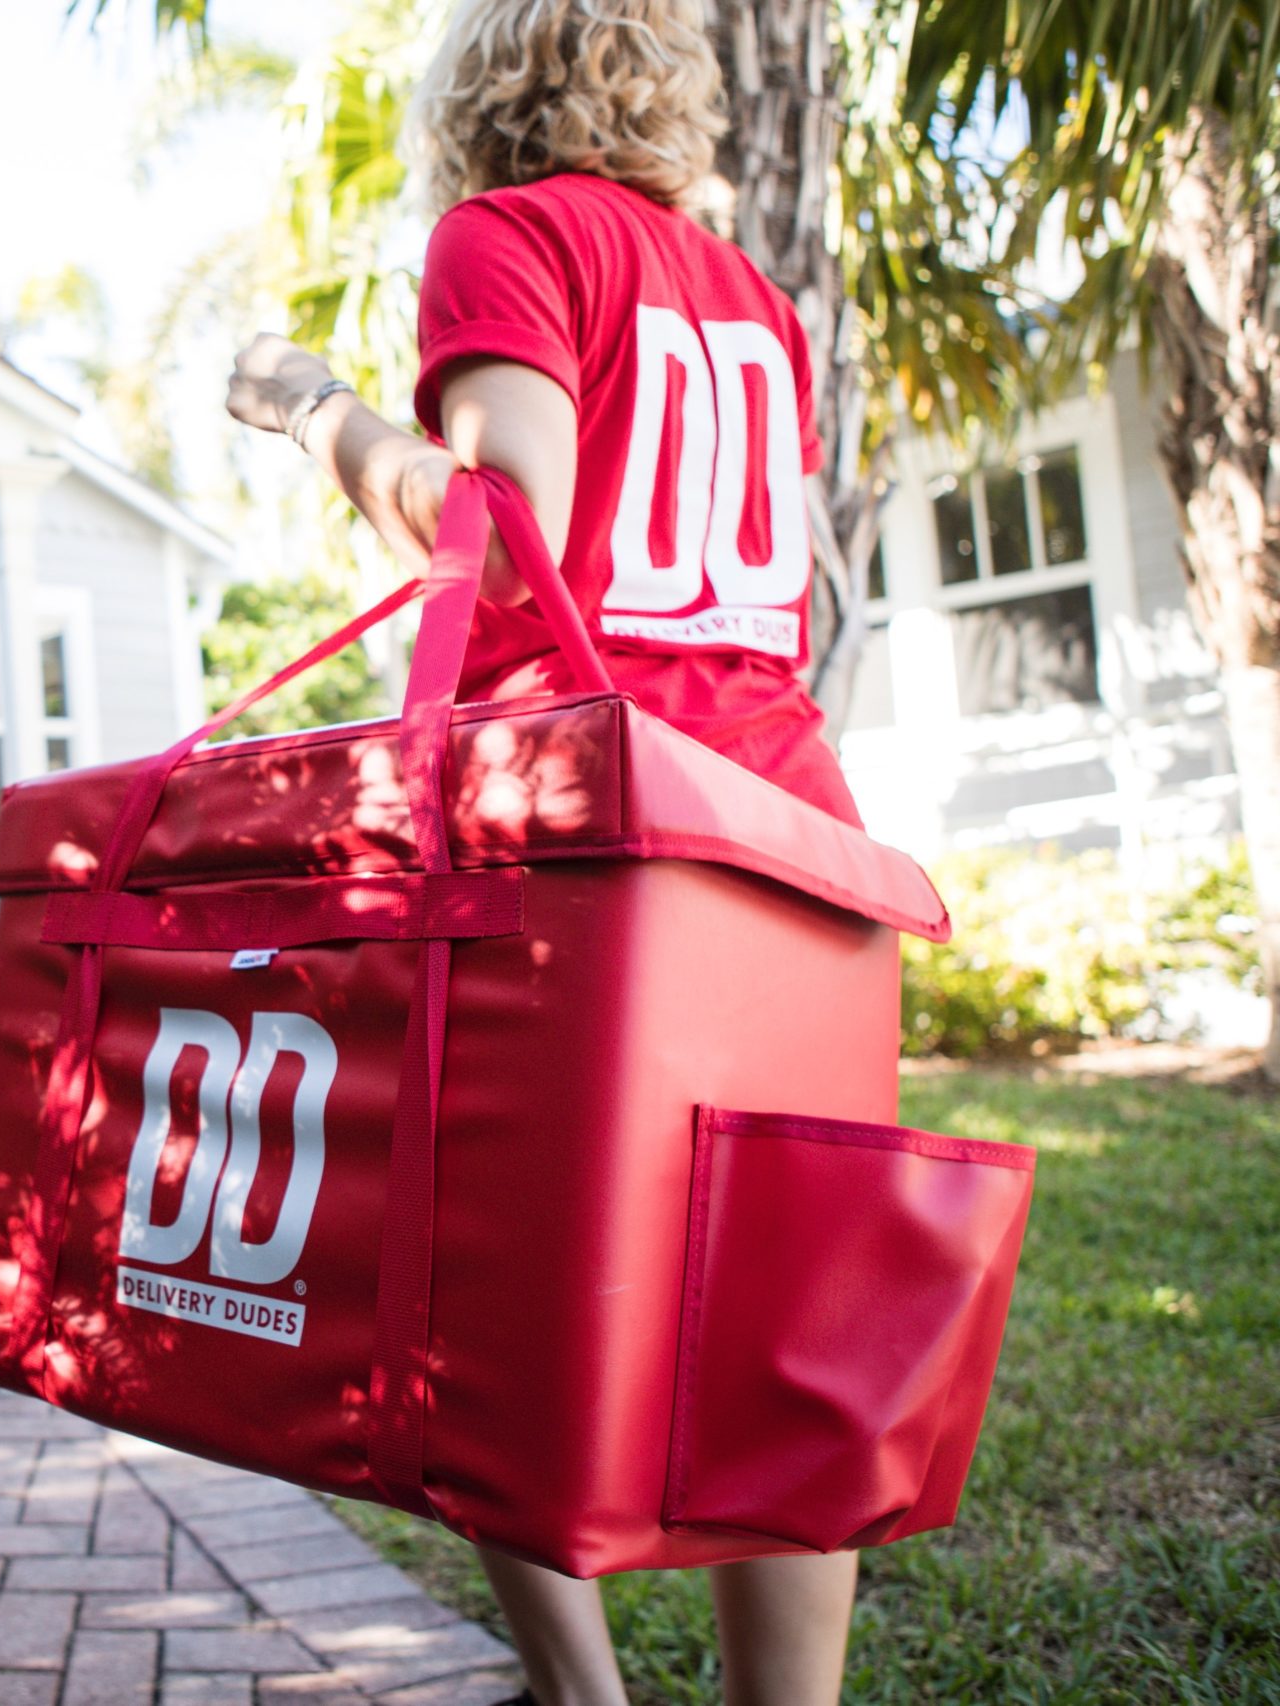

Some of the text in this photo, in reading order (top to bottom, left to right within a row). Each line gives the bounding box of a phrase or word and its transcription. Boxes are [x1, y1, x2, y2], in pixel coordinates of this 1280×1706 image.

[601, 303, 811, 612] DD
[118, 1007, 338, 1285] DD
[123, 1276, 298, 1335] DELIVERY DUDES
